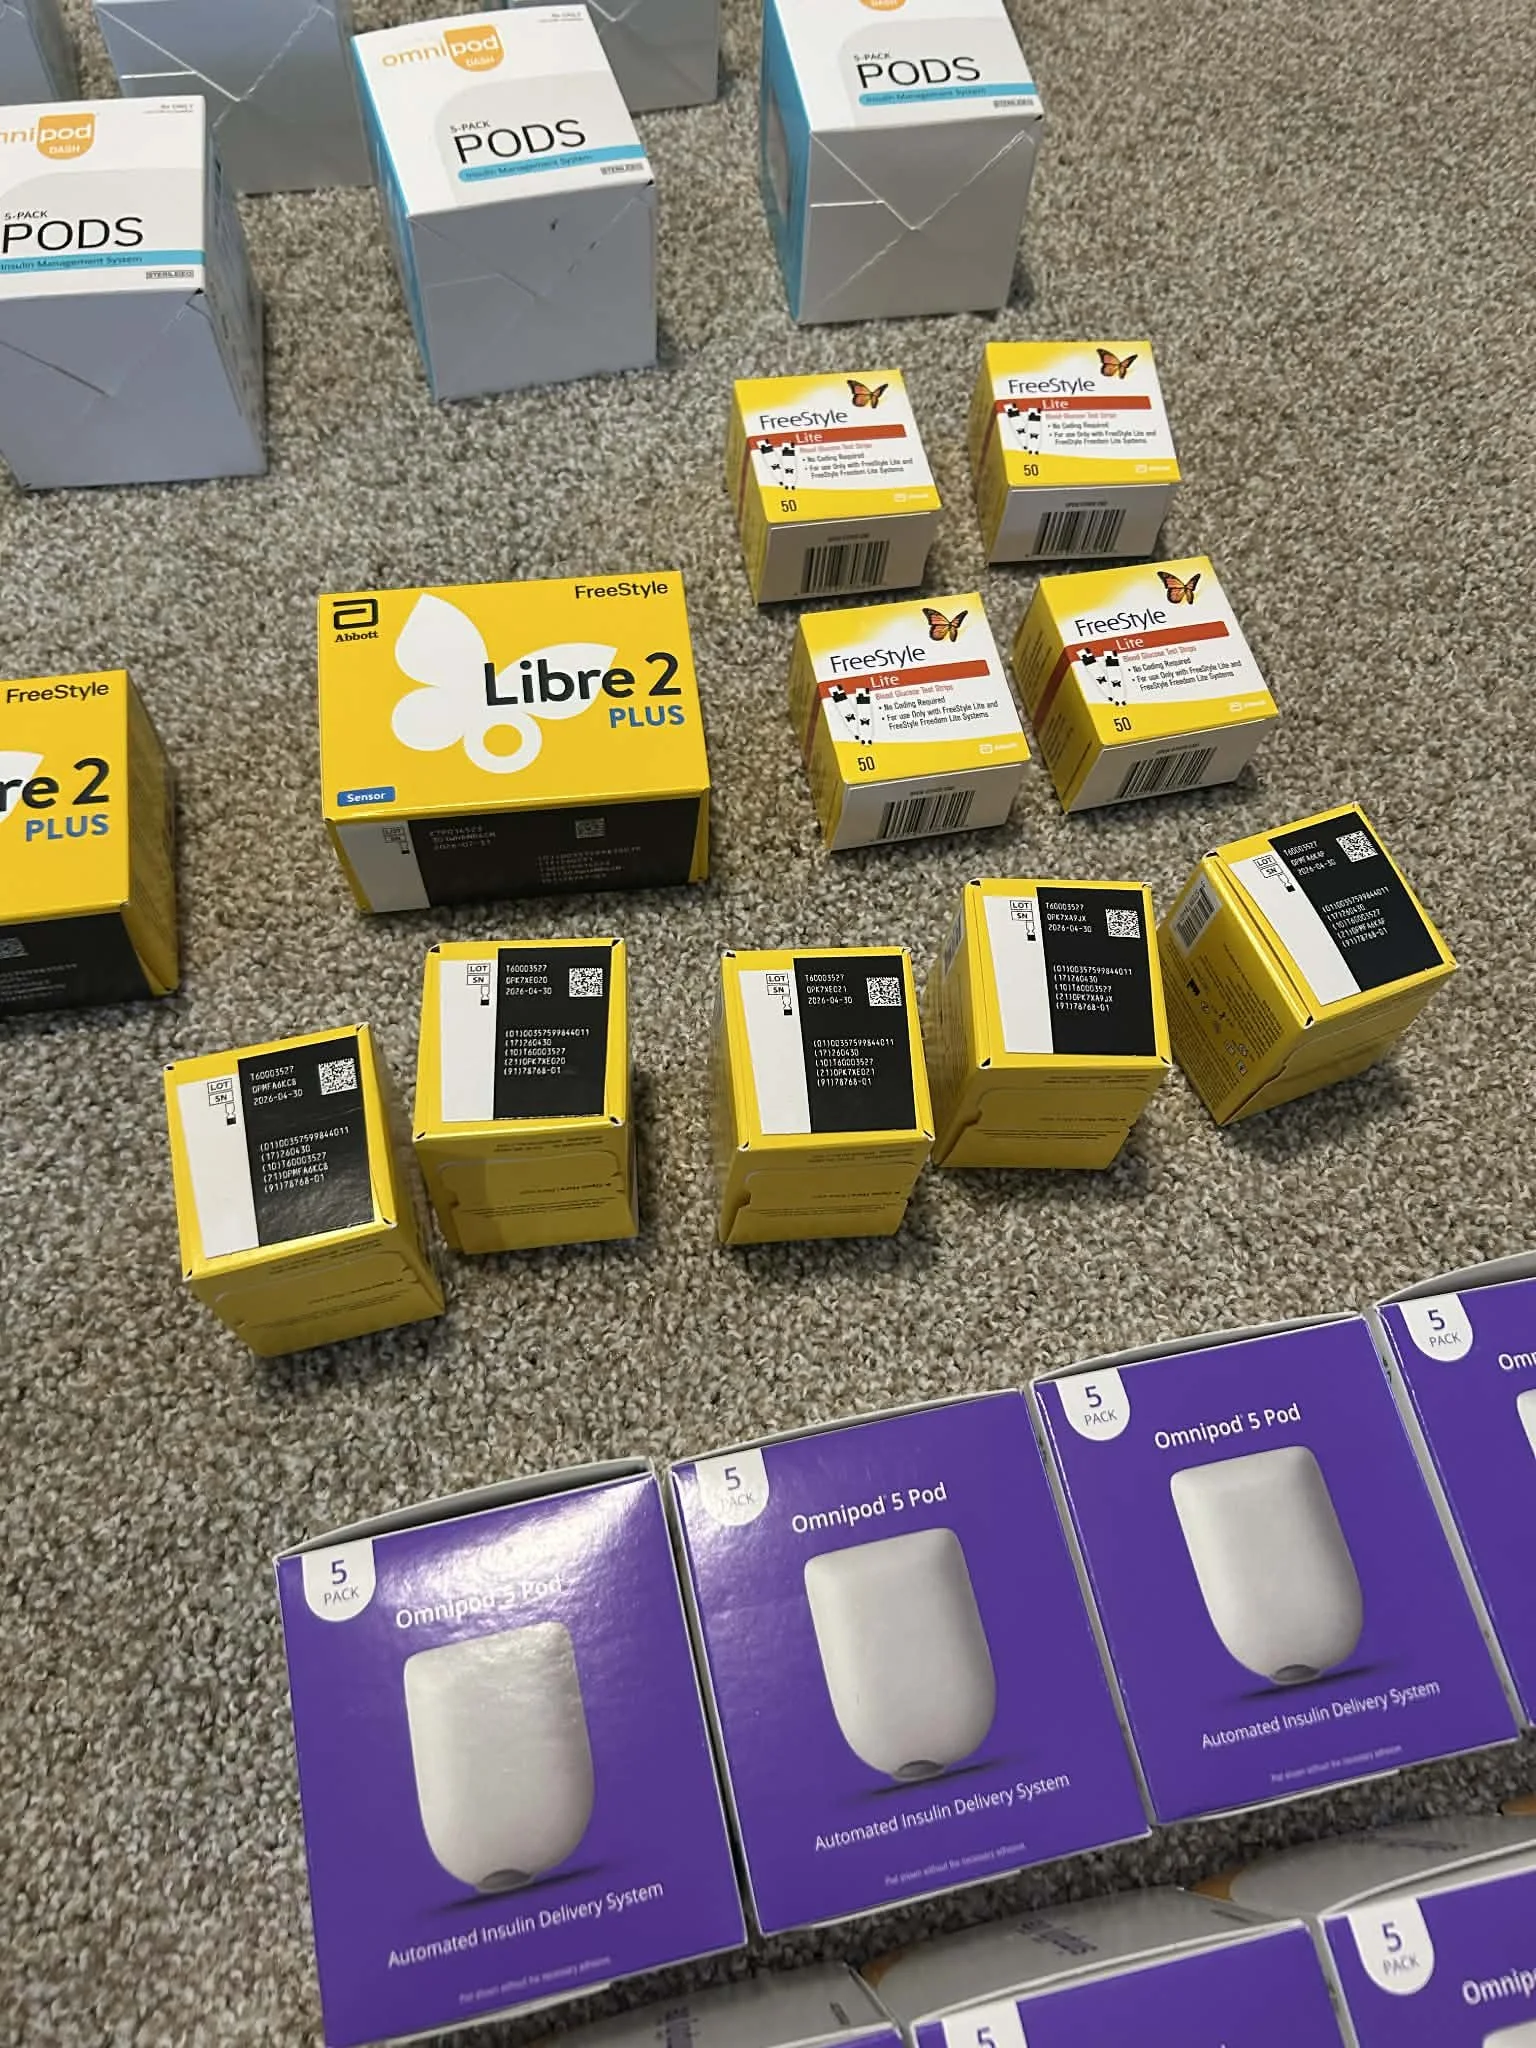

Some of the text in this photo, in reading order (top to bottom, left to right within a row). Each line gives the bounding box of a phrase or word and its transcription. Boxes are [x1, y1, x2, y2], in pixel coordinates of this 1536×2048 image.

[382, 34, 499, 67] omnipod
[856, 57, 981, 89] PODS
[450, 120, 490, 132] 5-PACK
[454, 119, 586, 164] PODS
[3, 209, 47, 221] 5-PACK
[2, 215, 143, 254] PODS
[1, 252, 142, 270] Insulin Management System
[1008, 377, 1096, 394] FreeStyle
[1041, 399, 1070, 409] Lite
[759, 409, 848, 430] FreeStyle
[794, 431, 824, 444] Lite
[1023, 464, 1039, 476] 50
[780, 499, 797, 512] 50
[574, 581, 669, 600] FreeStyle
[1074, 608, 1167, 637] FreeStyle
[335, 631, 379, 643] Abbott
[1115, 638, 1144, 650] Lite
[830, 645, 926, 673] FreeStyle
[1142, 662, 1164, 671] Coding
[1163, 657, 1192, 667] Required
[484, 651, 682, 707] Libre 2
[870, 675, 900, 688] Lite
[1136, 675, 1147, 683] For
[1159, 671, 1175, 679] Only
[1175, 668, 1189, 676] with
[1188, 664, 1218, 674] FreeStyle
[1139, 680, 1169, 692] FreeStyle
[1168, 677, 1196, 686] Freedom
[1208, 671, 1235, 680] Systems
[6, 681, 110, 704] FreeStyle
[893, 701, 917, 710] Coding
[917, 696, 946, 706] Required
[911, 710, 926, 718] Only
[927, 708, 942, 716] with
[942, 704, 972, 714] FreeStyle
[986, 700, 998, 708] and
[608, 704, 686, 729] PLUS
[888, 720, 919, 730] FreeStyle
[919, 717, 948, 726] Freedom
[962, 712, 989, 721] Systems
[1113, 717, 1132, 732] 50
[857, 756, 875, 772] 50
[72, 757, 111, 805] 2
[346, 791, 387, 803] Sensor
[25, 814, 110, 842] PLUS
[1256, 857, 1272, 866] LOT
[1297, 858, 1336, 876] 2026-04-30
[1045, 902, 1084, 910] T60003527
[1048, 923, 1092, 932] 2026-04-30
[506, 964, 547, 973] T60003527
[1054, 974, 1098, 982] (17)260430
[505, 987, 552, 995] 2026-04-30
[808, 996, 853, 1004] 2026-04-30
[1056, 1002, 1109, 1011] (91)78768-01
[505, 1038, 552, 1046] (17)260430
[814, 1048, 859, 1057] (17)260430
[503, 1066, 560, 1075] (91)78768-01
[210, 1081, 228, 1091] LOT
[817, 1077, 871, 1086] (91)78768-01
[215, 1094, 227, 1102] SN
[253, 1089, 303, 1106] 2026-04-30
[1426, 1308, 1446, 1331] 5
[1428, 1331, 1461, 1347] PACK
[1083, 1384, 1104, 1409] 5
[1082, 1407, 1118, 1427] PACK
[1155, 1402, 1301, 1449] Omnipod 5 Pod
[723, 1465, 743, 1492] 5
[719, 1490, 755, 1511] PACK
[791, 1481, 947, 1534] Omnipod 5 Pod
[329, 1558, 348, 1585] 5
[322, 1585, 360, 1607] PACK
[396, 1593, 495, 1629] Omnipod
[522, 1574, 562, 1598] Pod
[1202, 1682, 1440, 1749] Automated Insulin Delivery System
[815, 1775, 1070, 1851] Automated Insulin Delivery System
[388, 1883, 663, 1969] Automated Insulin Delivery System
[1381, 1920, 1403, 1953] 5
[1381, 1952, 1420, 1975] PACK
